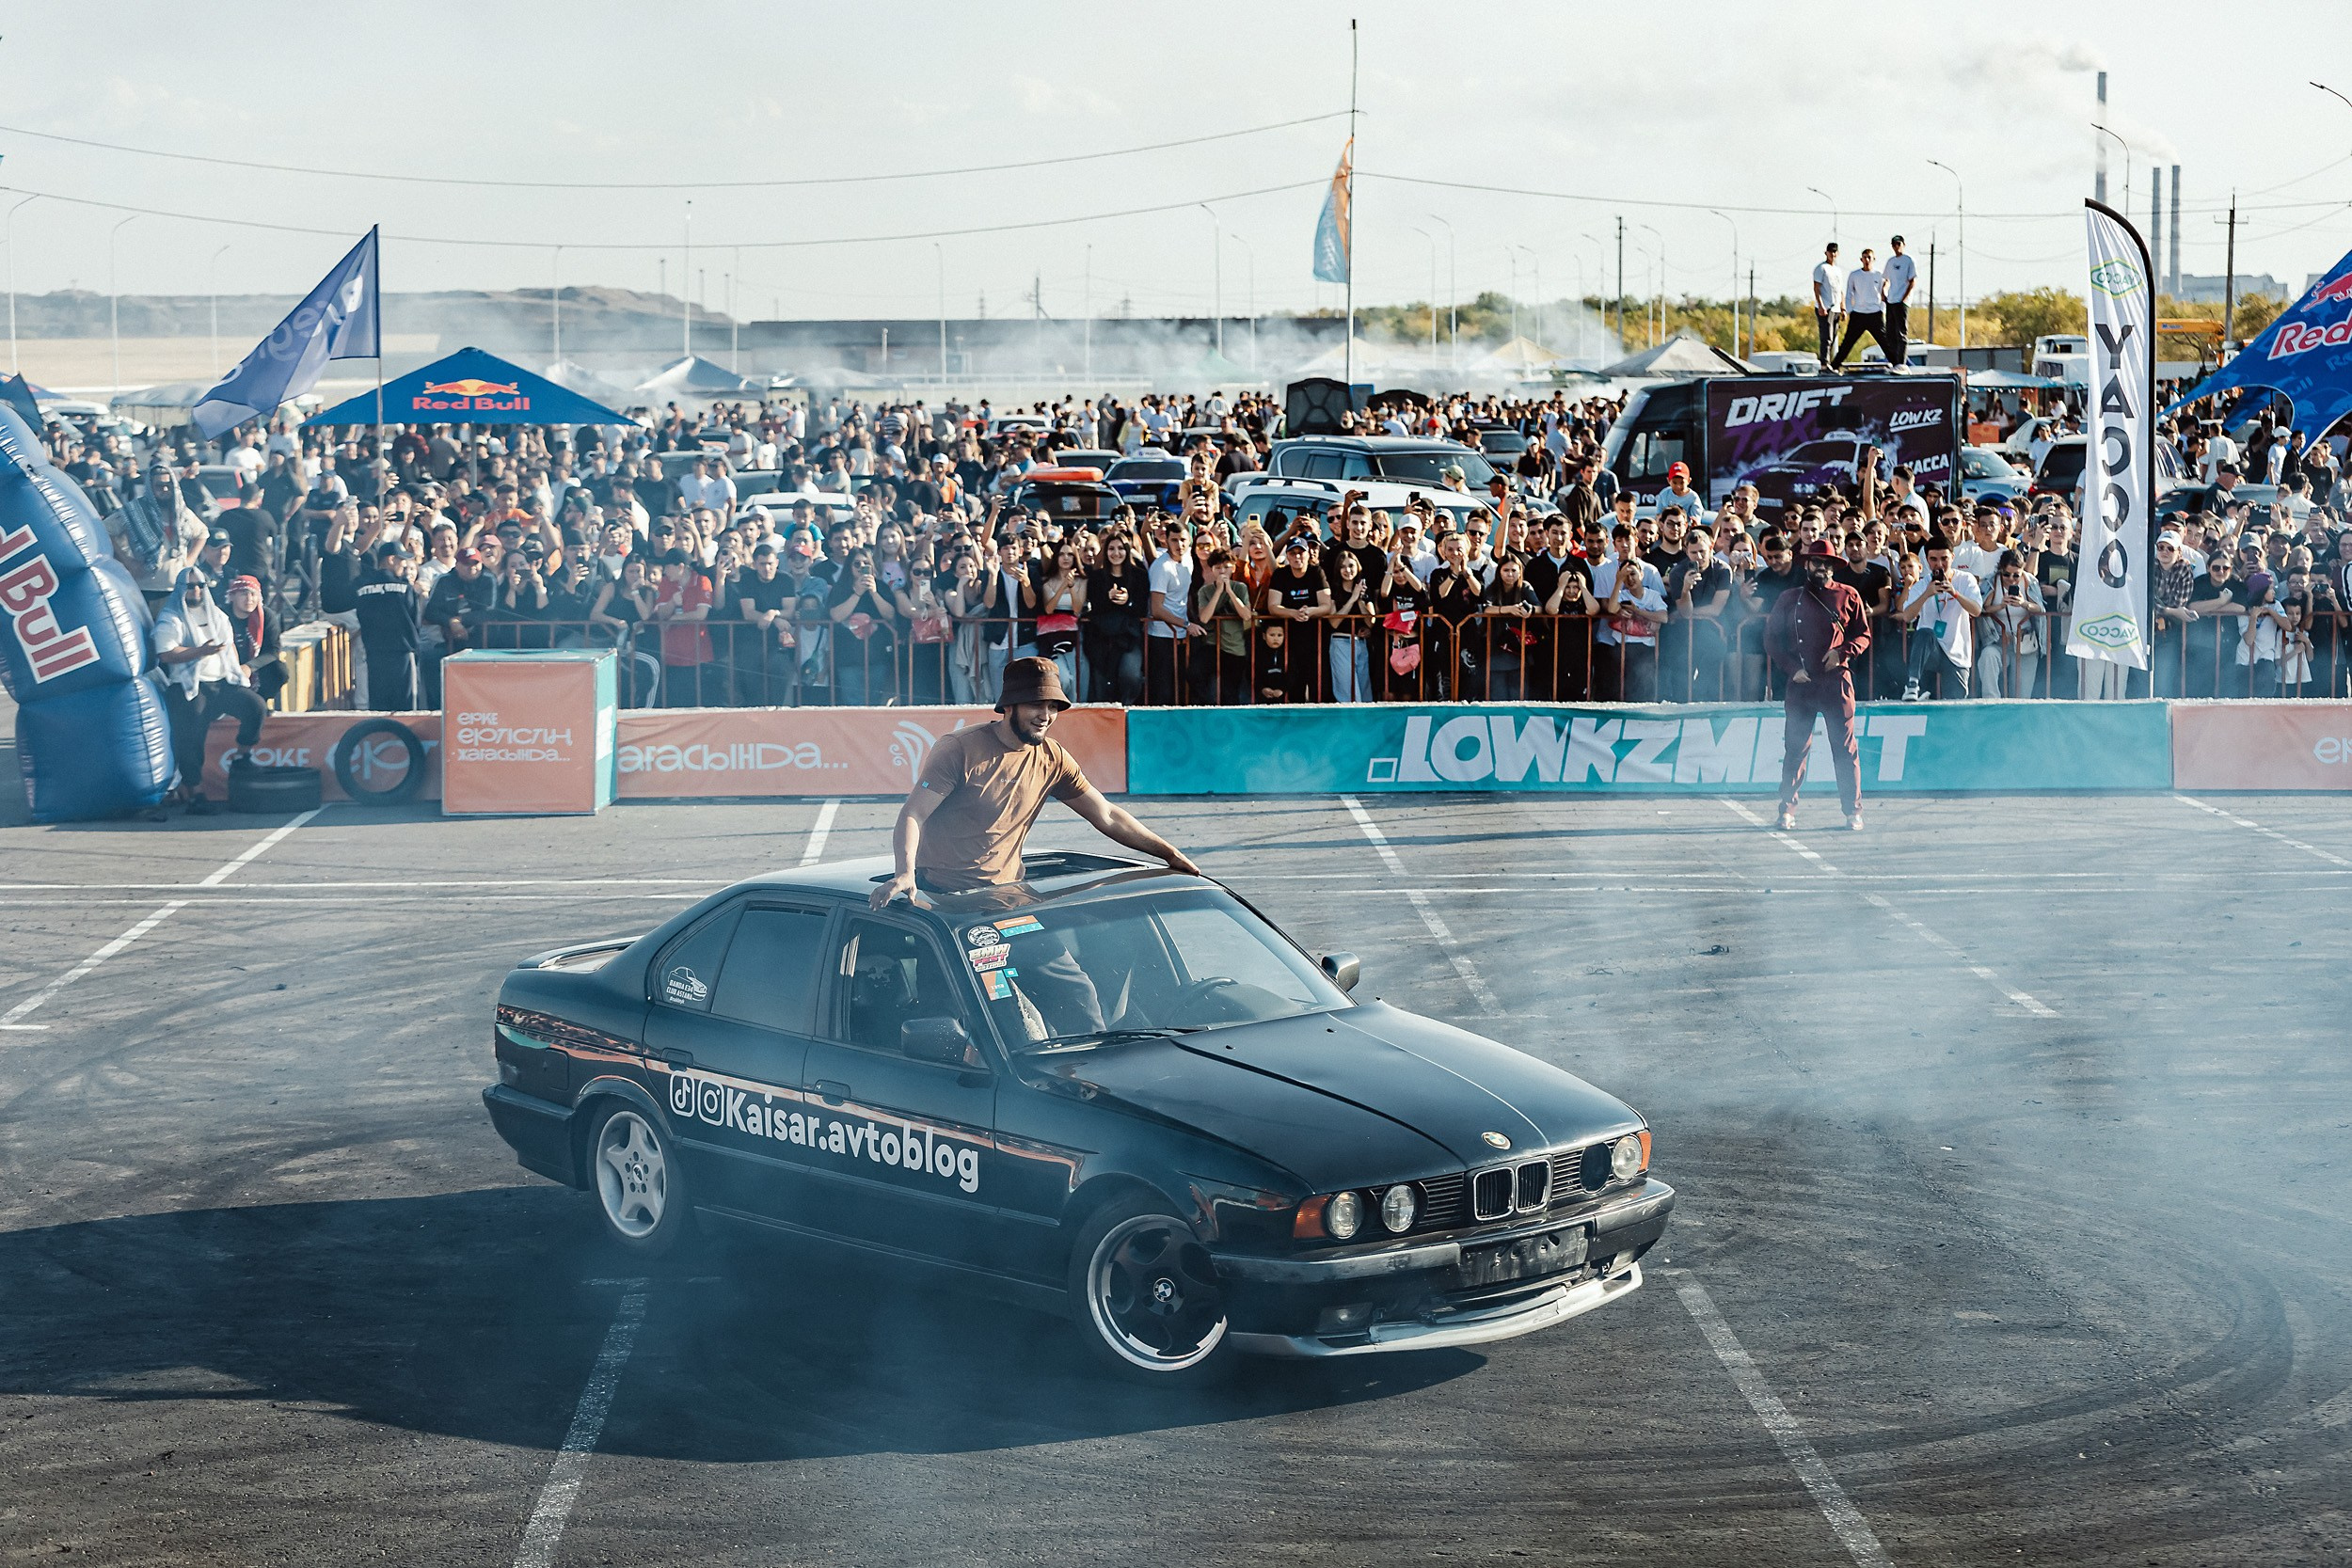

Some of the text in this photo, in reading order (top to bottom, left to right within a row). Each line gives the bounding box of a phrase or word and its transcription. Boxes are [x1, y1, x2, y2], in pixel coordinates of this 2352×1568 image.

[412, 396, 531, 411] Red Bull
[1724, 386, 1853, 428] DRIFT
[1724, 408, 1823, 466] TAX
[0, 556, 97, 681] Bull
[971, 944, 1009, 960] BMW
[725, 1087, 980, 1193] Kaisar.avtoblog
